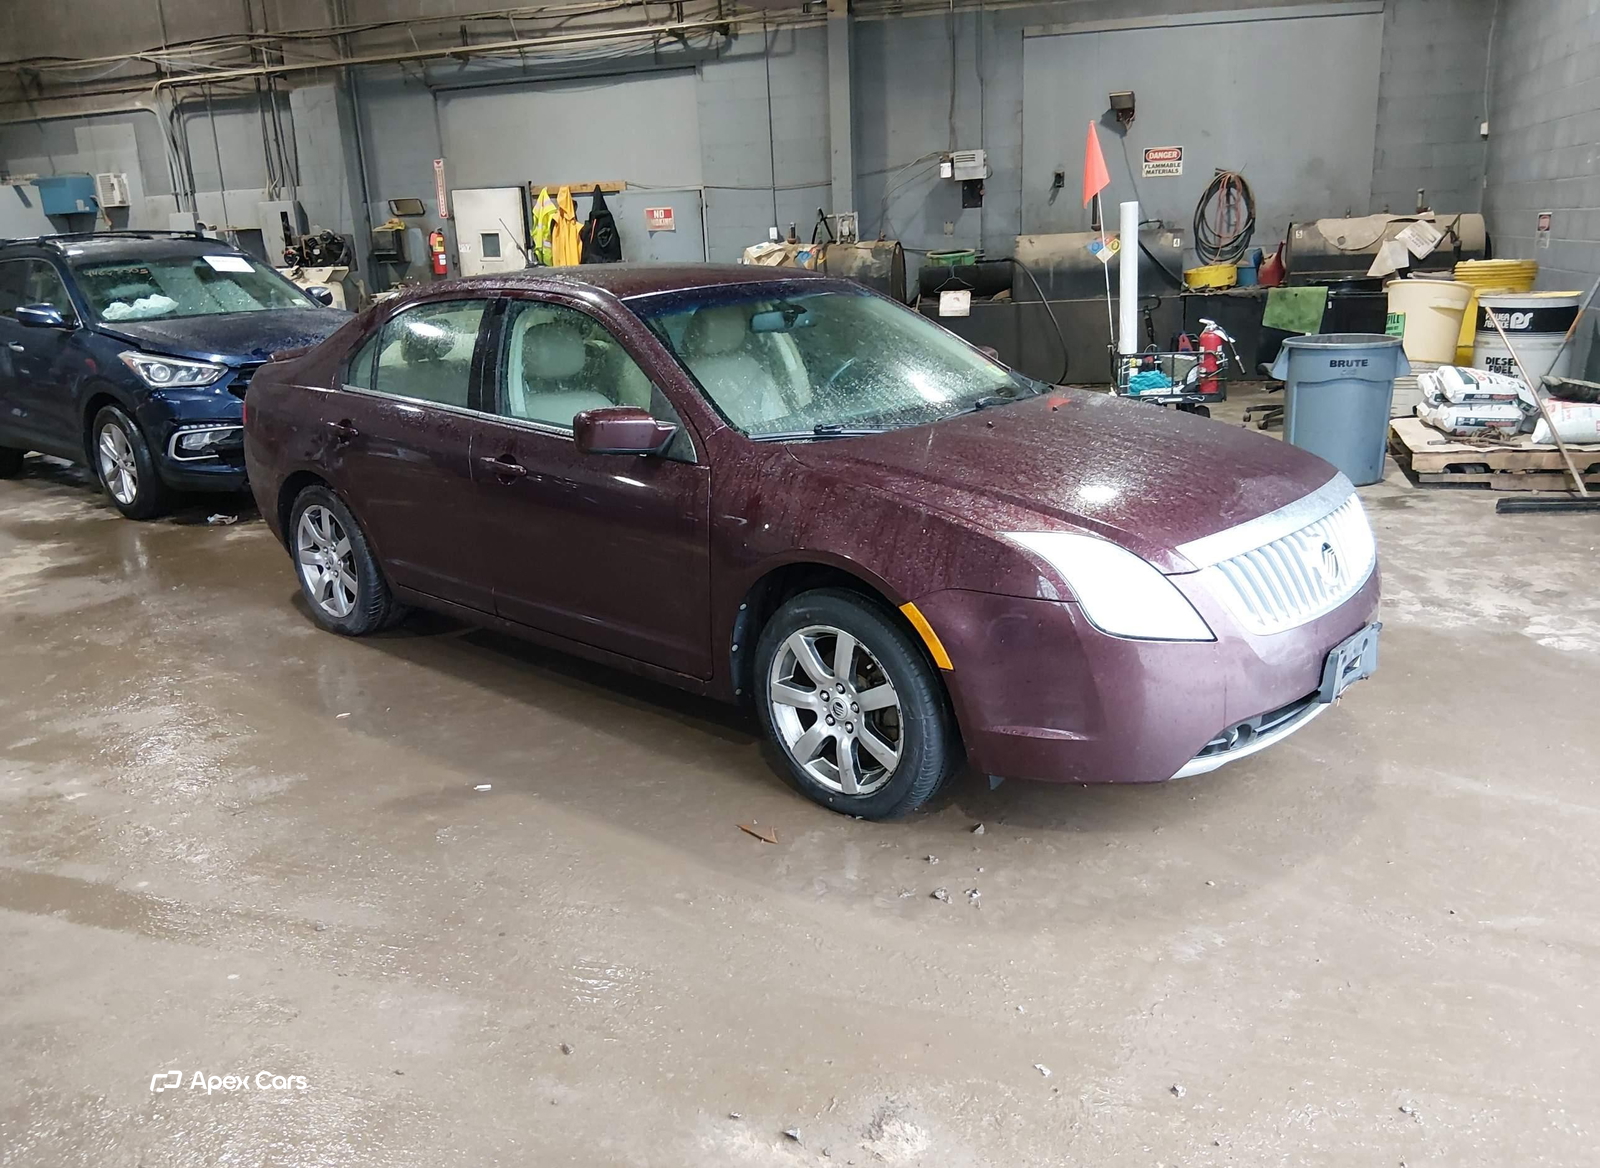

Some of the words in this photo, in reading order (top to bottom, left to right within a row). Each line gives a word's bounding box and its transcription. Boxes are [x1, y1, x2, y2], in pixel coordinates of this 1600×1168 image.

[1149, 151, 1177, 160] DANGER
[653, 210, 665, 218] NO
[1386, 314, 1400, 324] PILL
[1329, 359, 1369, 368] BRUTE
[1489, 365, 1513, 375] FUEL
